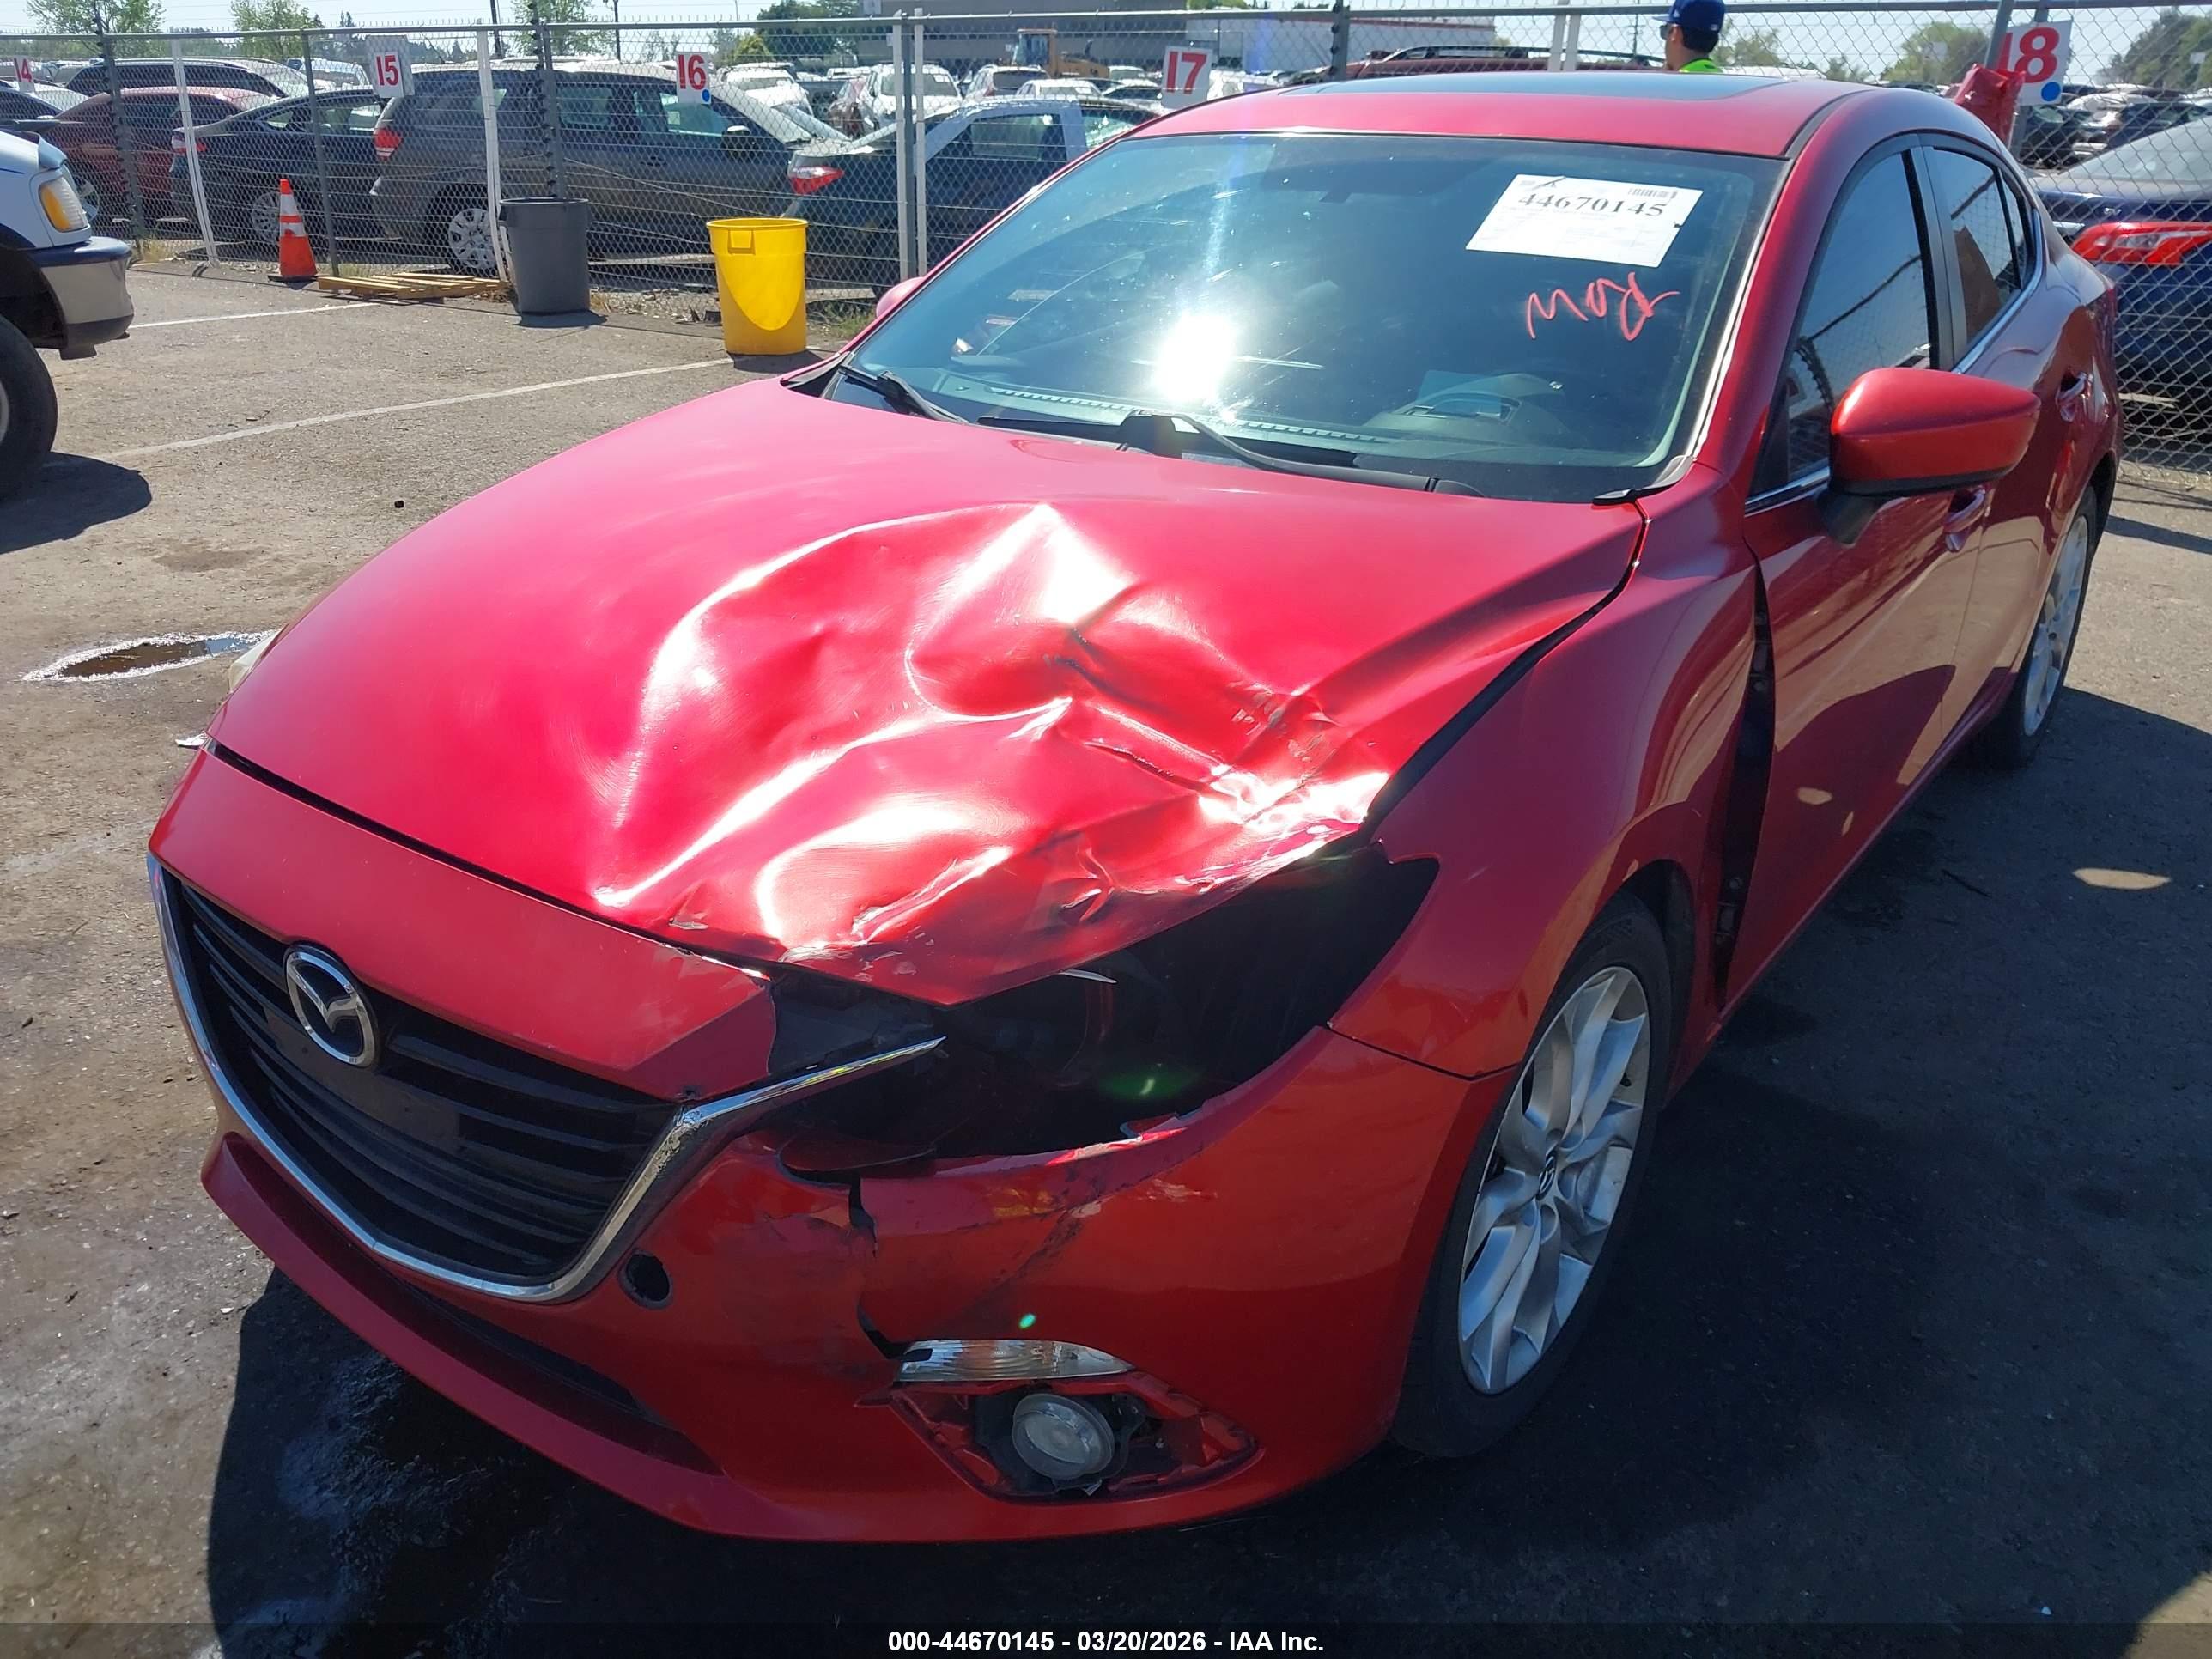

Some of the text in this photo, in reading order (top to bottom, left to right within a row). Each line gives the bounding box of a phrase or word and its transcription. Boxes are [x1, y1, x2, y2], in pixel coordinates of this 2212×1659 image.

[14, 58, 32, 82] 14
[376, 55, 399, 86] 15
[1997, 27, 2060, 83] 18
[678, 54, 706, 90] 16
[1166, 51, 1207, 94] 17
[1518, 193, 1667, 216] 44670145
